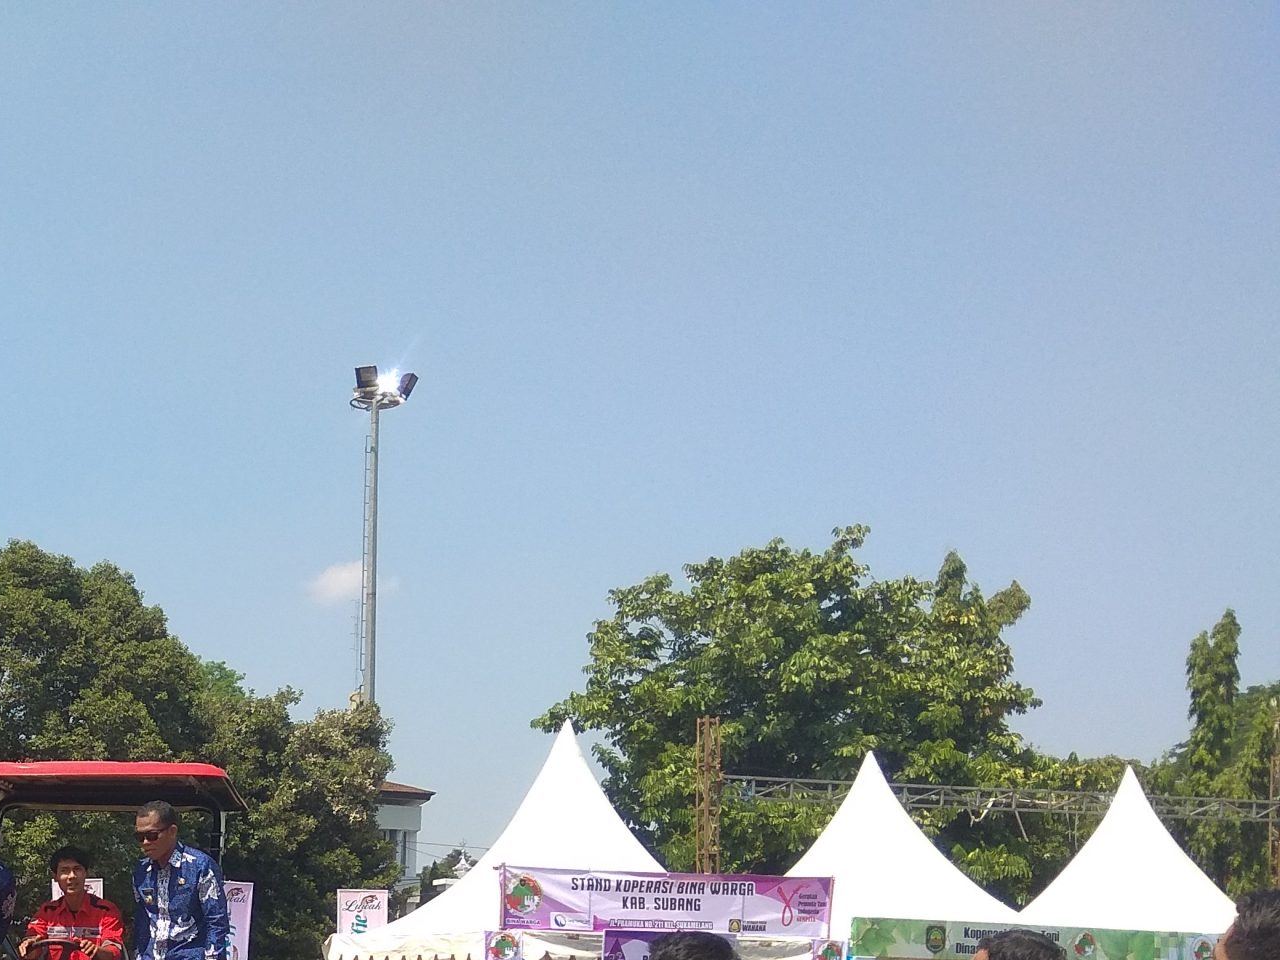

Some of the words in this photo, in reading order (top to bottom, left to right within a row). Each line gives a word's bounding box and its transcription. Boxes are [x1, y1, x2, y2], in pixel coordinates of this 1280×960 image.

[571, 877, 611, 892] STAND
[615, 879, 674, 894] KOPERASI
[677, 881, 705, 895] BINA
[709, 882, 754, 896] WARGA
[622, 896, 650, 910] KAB.
[654, 897, 701, 912] SUBANG
